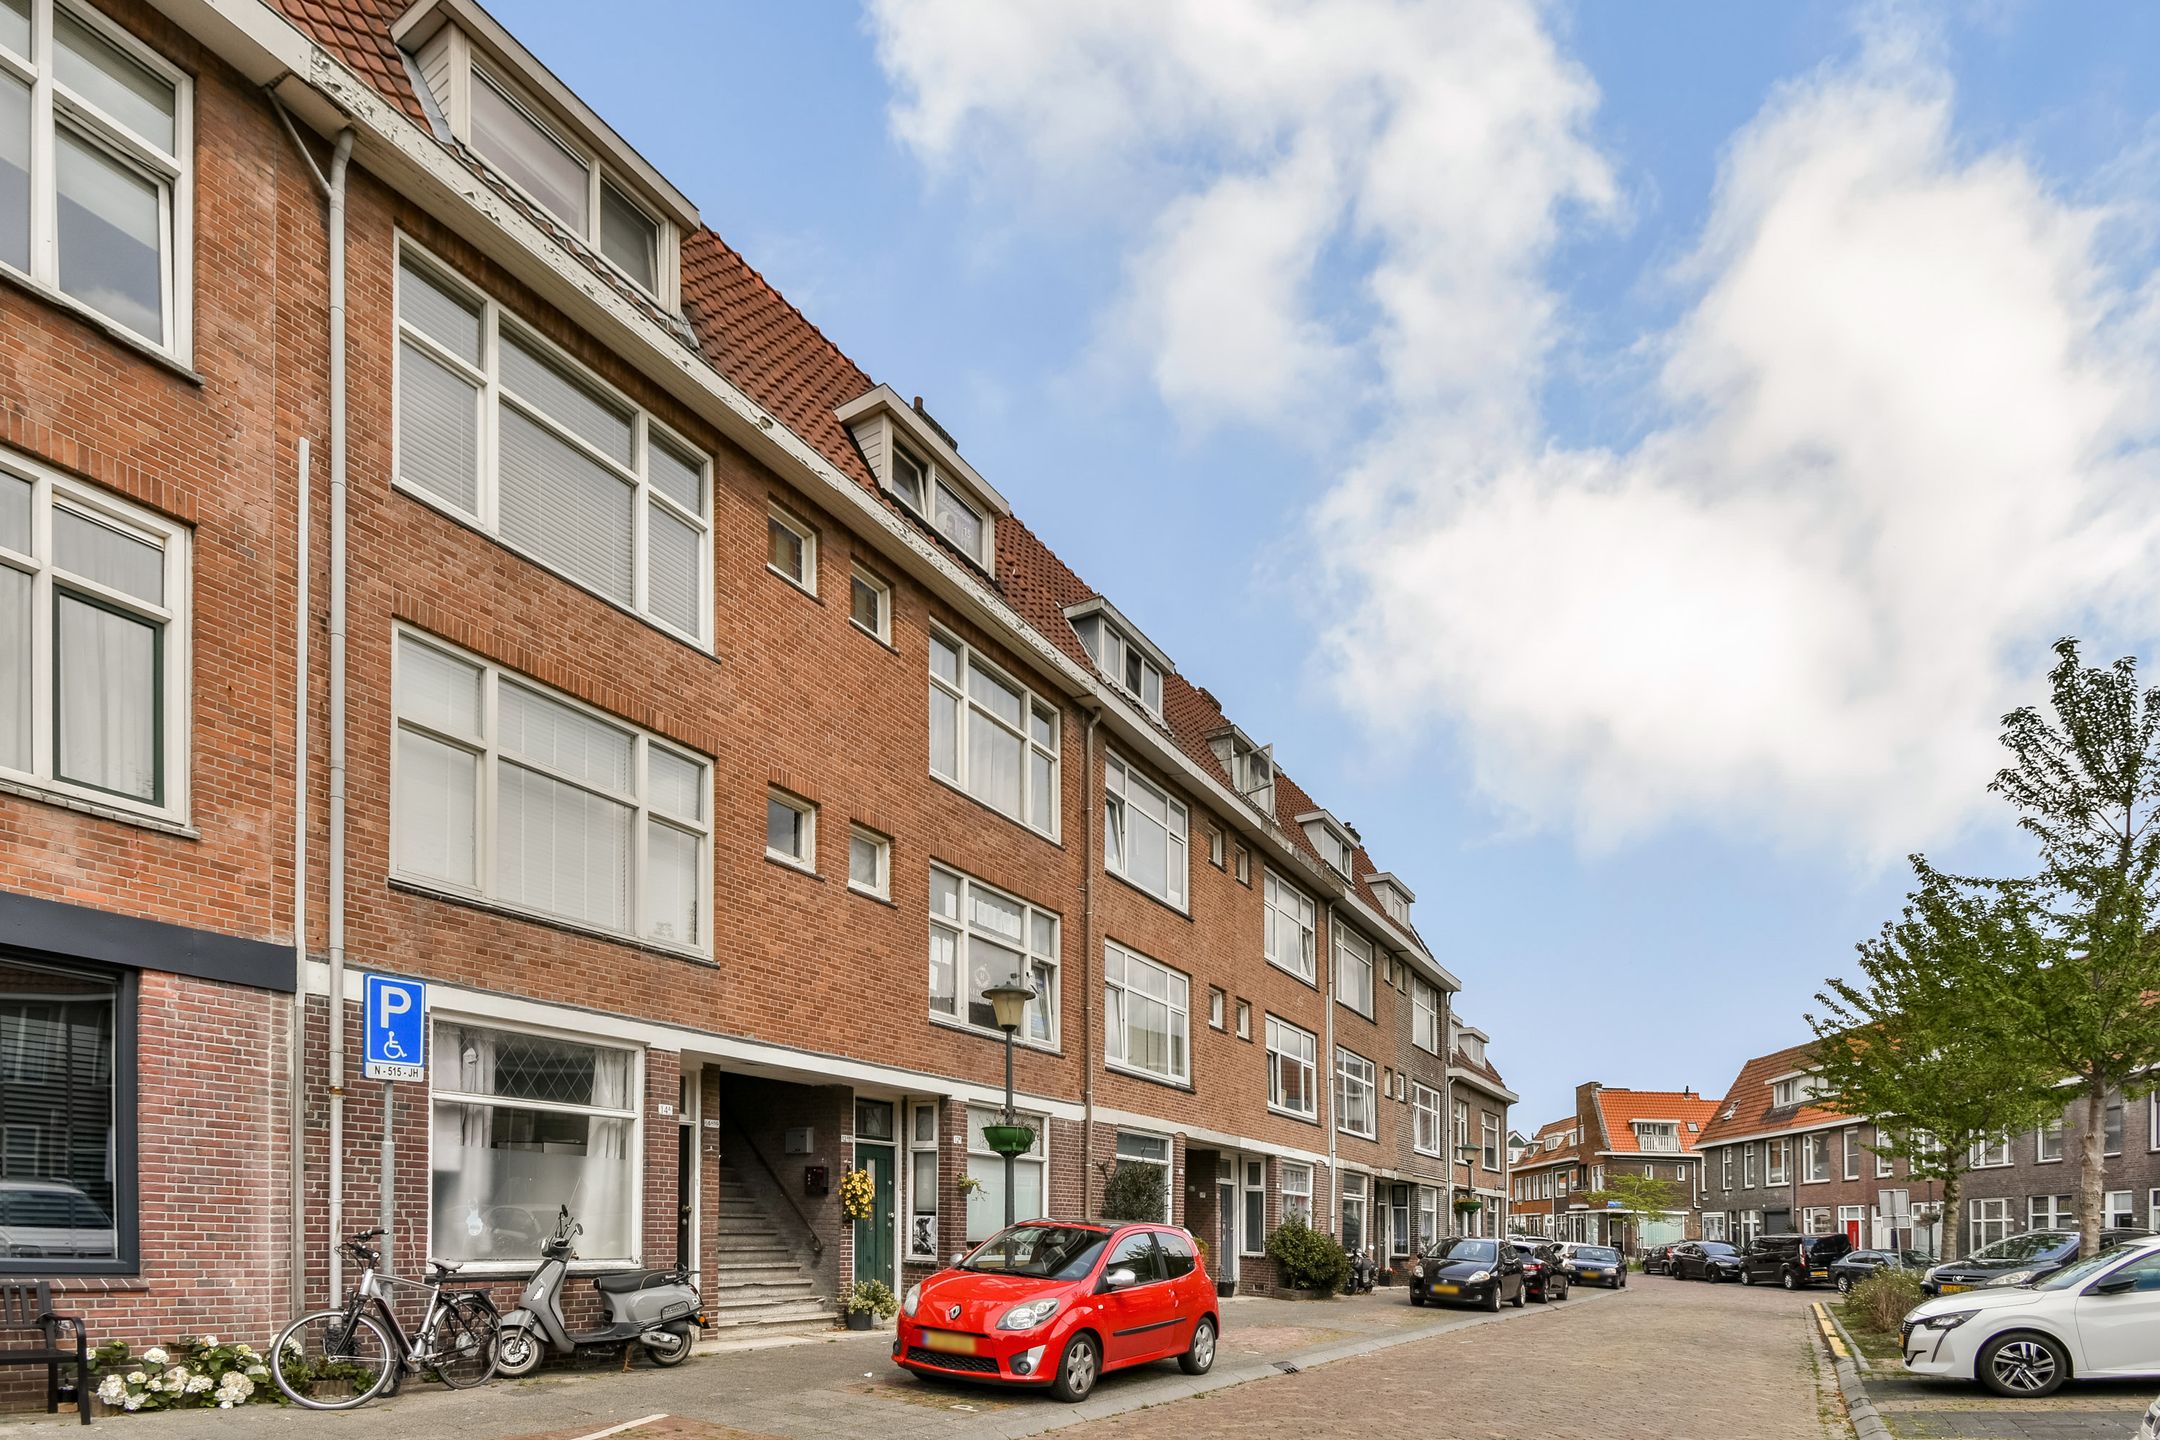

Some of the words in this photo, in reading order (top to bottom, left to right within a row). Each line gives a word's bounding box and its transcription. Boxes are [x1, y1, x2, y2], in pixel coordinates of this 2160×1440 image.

[381, 985, 412, 1028] P
[374, 1065, 381, 1075] N
[388, 1066, 402, 1077] 515
[408, 1068, 419, 1078] JH
